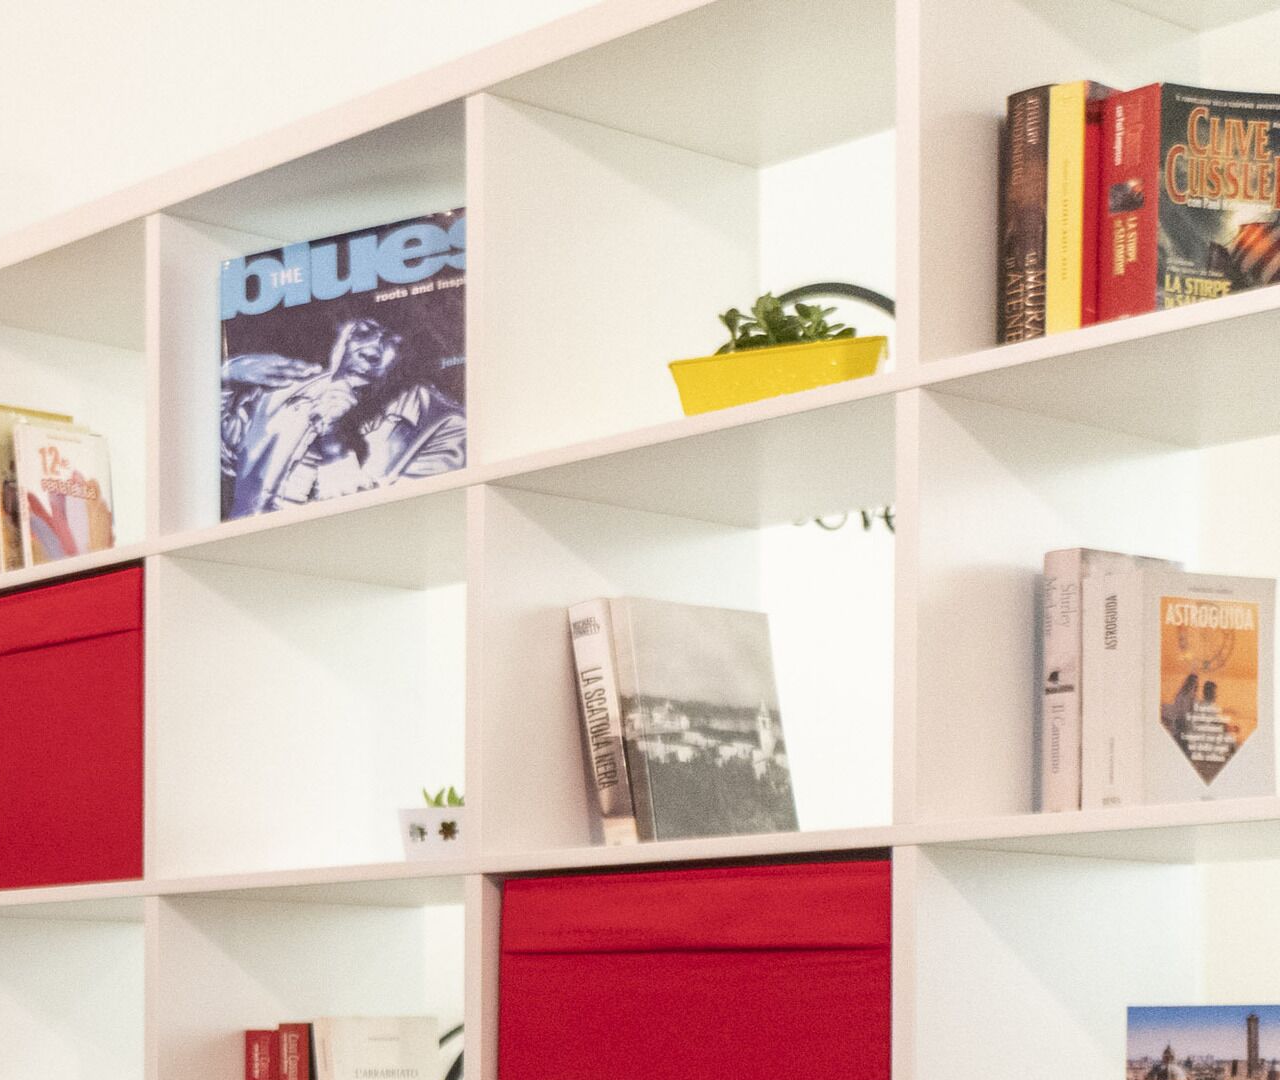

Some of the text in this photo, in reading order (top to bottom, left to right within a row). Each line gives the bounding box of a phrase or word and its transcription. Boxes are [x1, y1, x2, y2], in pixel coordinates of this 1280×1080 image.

[1187, 106, 1270, 161] CLIVE
[270, 267, 305, 289] THE
[375, 288, 409, 302] roots
[411, 282, 434, 296] and
[1164, 272, 1182, 294] LA
[1024, 269, 1046, 338] MURA
[1103, 594, 1119, 651] ASTROGUIDA
[1165, 603, 1253, 631] ASTROGUIDA
[580, 666, 603, 687] LA
[584, 689, 615, 753] SCATOLA
